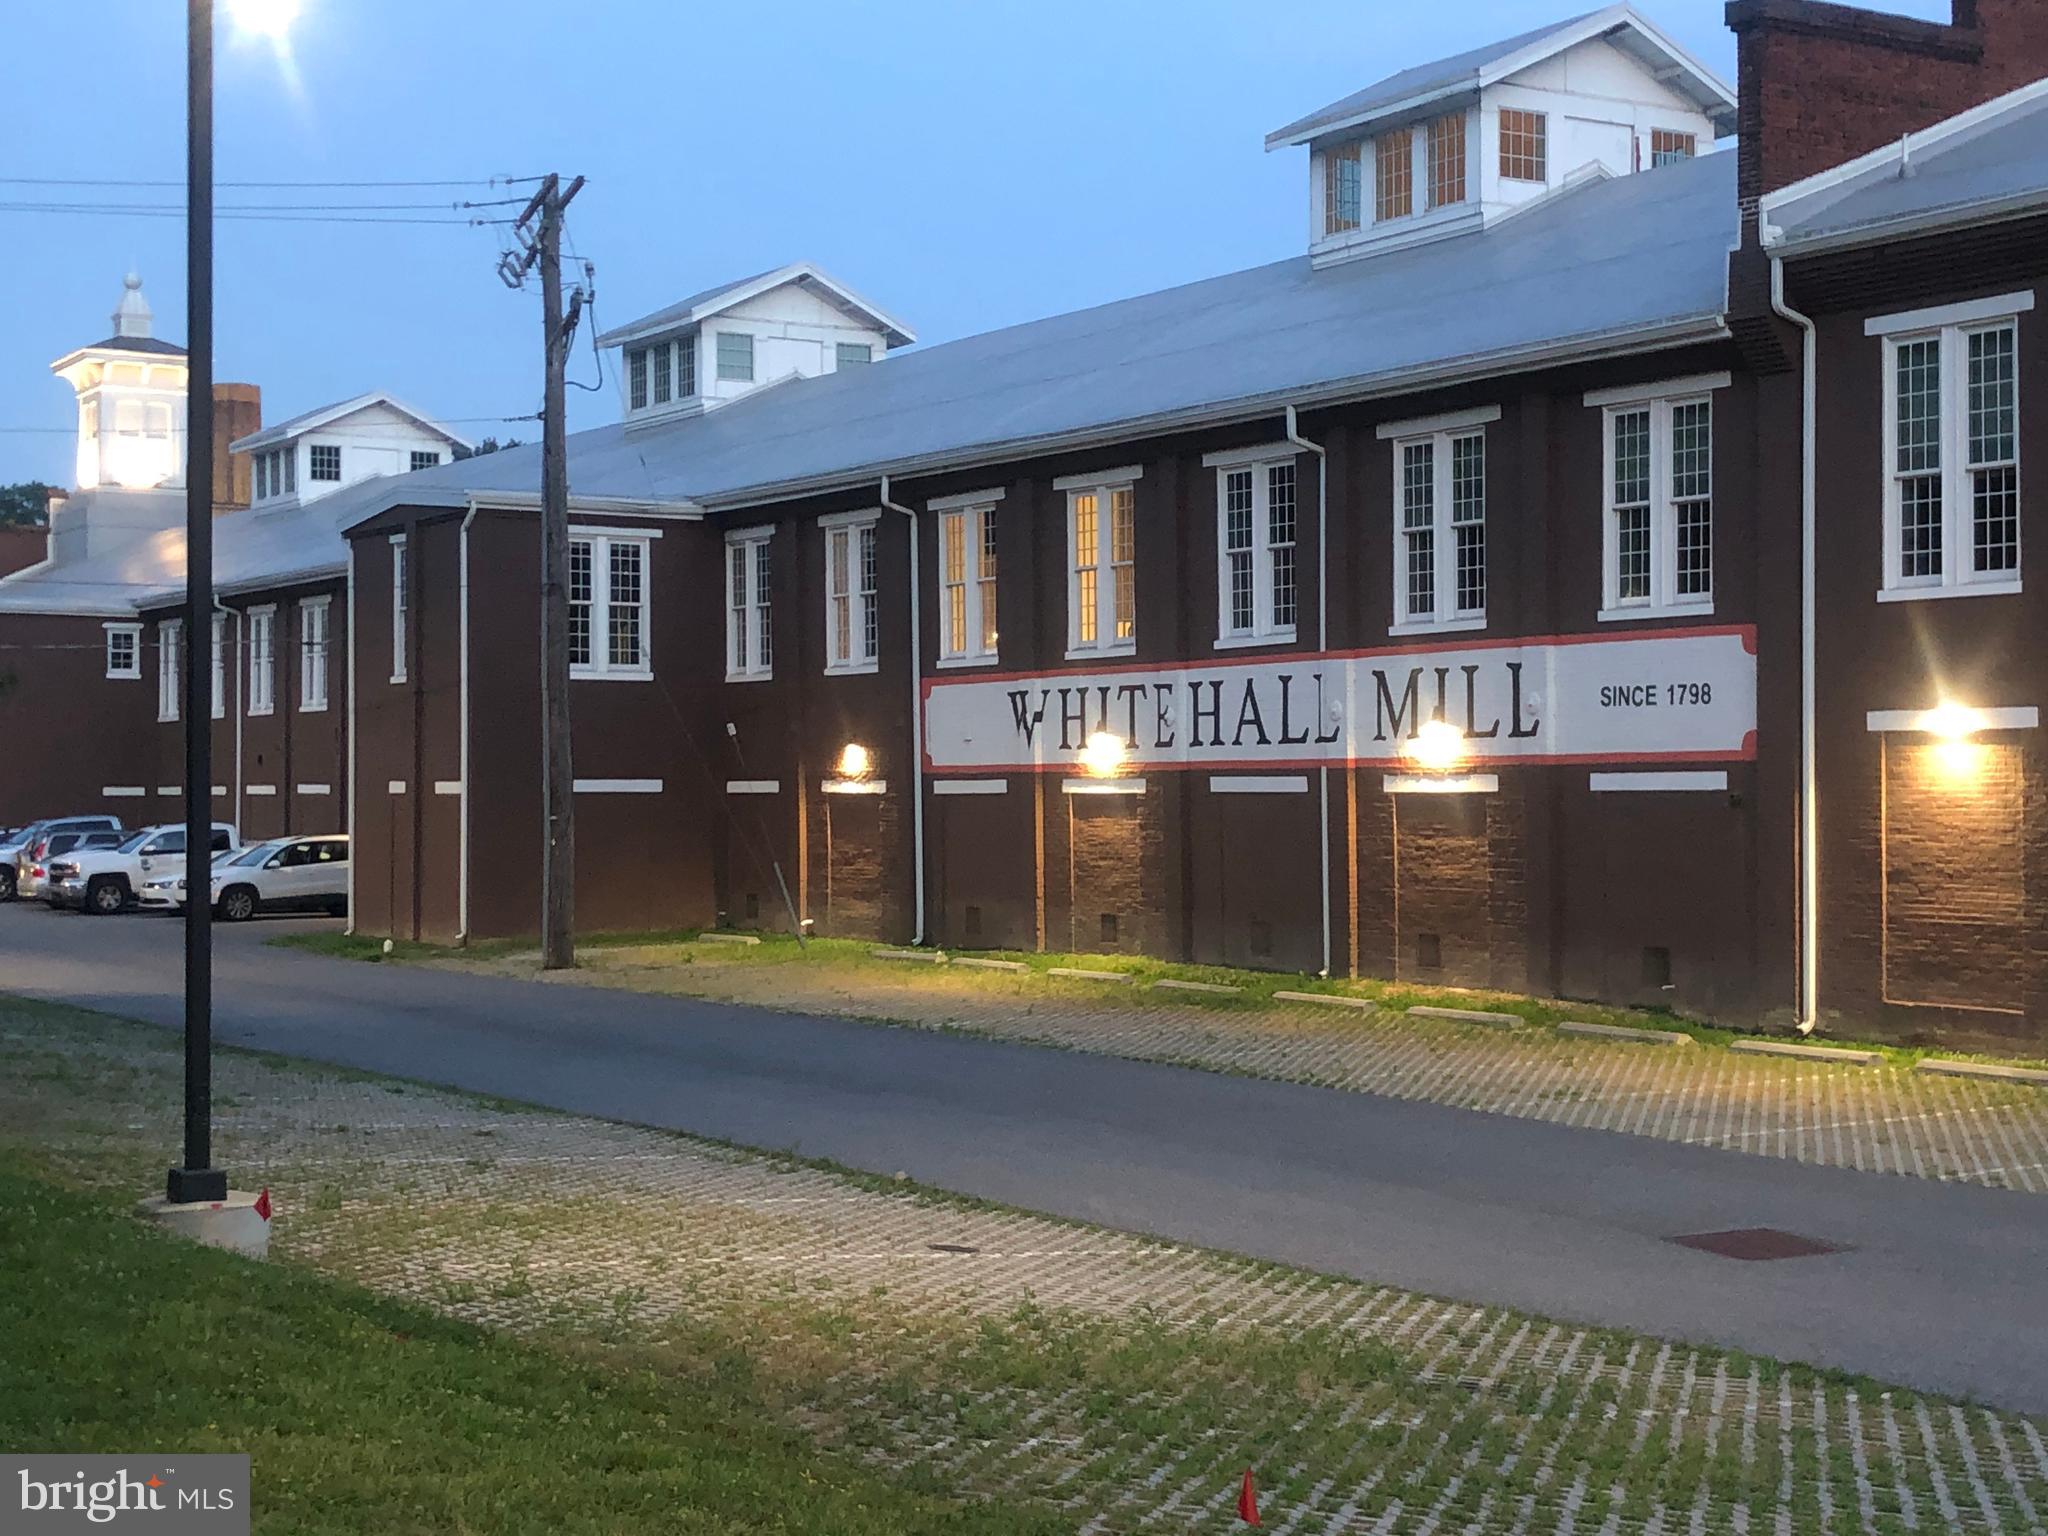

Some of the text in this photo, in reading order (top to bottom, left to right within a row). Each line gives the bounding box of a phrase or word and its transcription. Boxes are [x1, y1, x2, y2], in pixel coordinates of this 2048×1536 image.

[1007, 662, 1541, 750] WHITEHALL MILL
[1600, 682, 1713, 708] SINCE 1798
